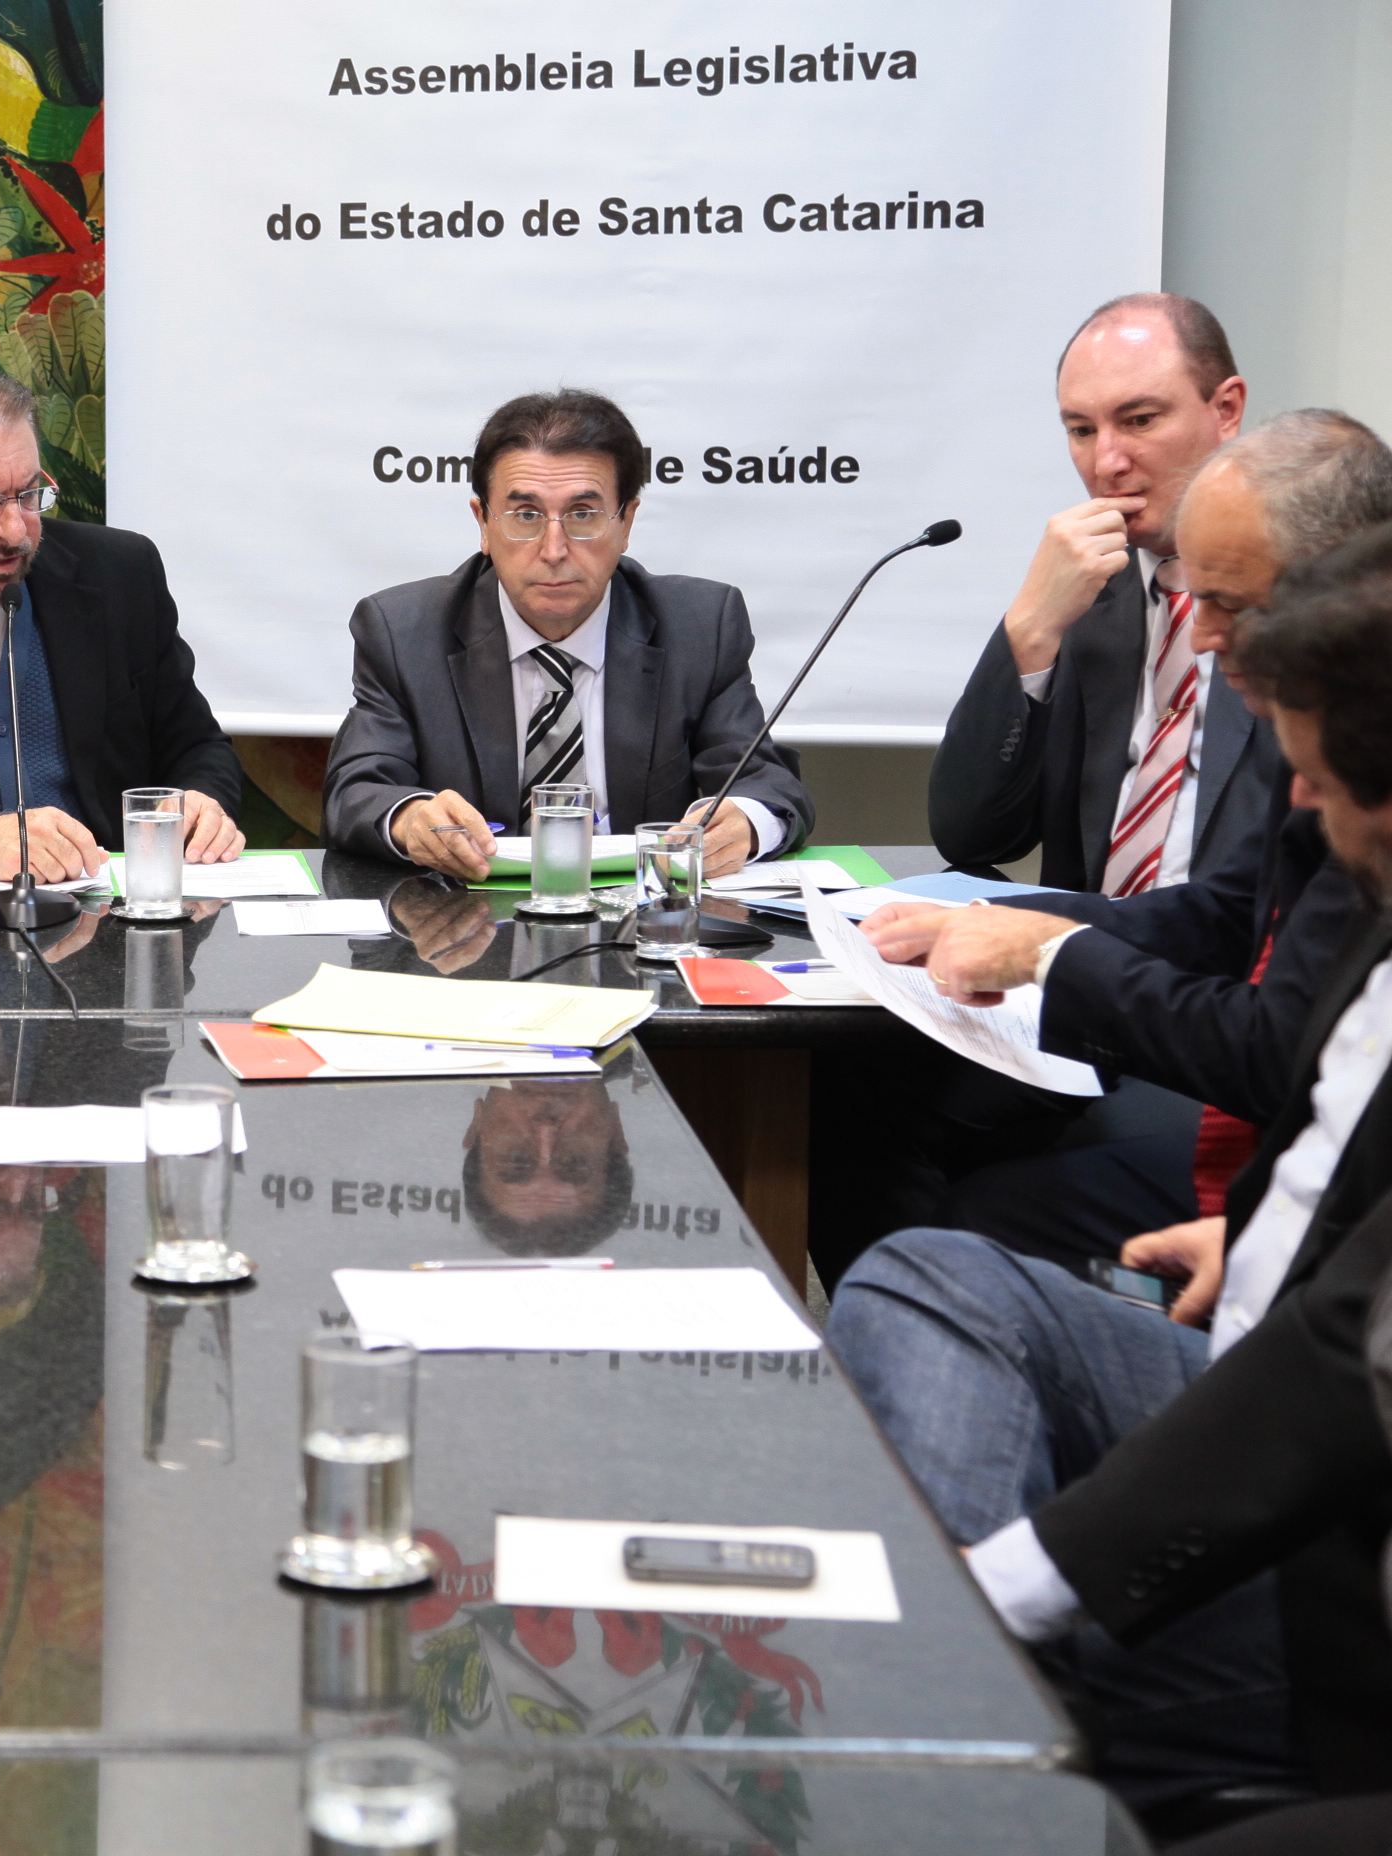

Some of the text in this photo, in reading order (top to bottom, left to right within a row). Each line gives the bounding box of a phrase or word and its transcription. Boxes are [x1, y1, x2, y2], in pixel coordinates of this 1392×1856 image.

[329, 43, 917, 97] Assembleia Legislativa
[267, 191, 984, 241] do Estado de Santa Catarina
[374, 447, 472, 483] Com
[702, 446, 860, 484] Saúde
